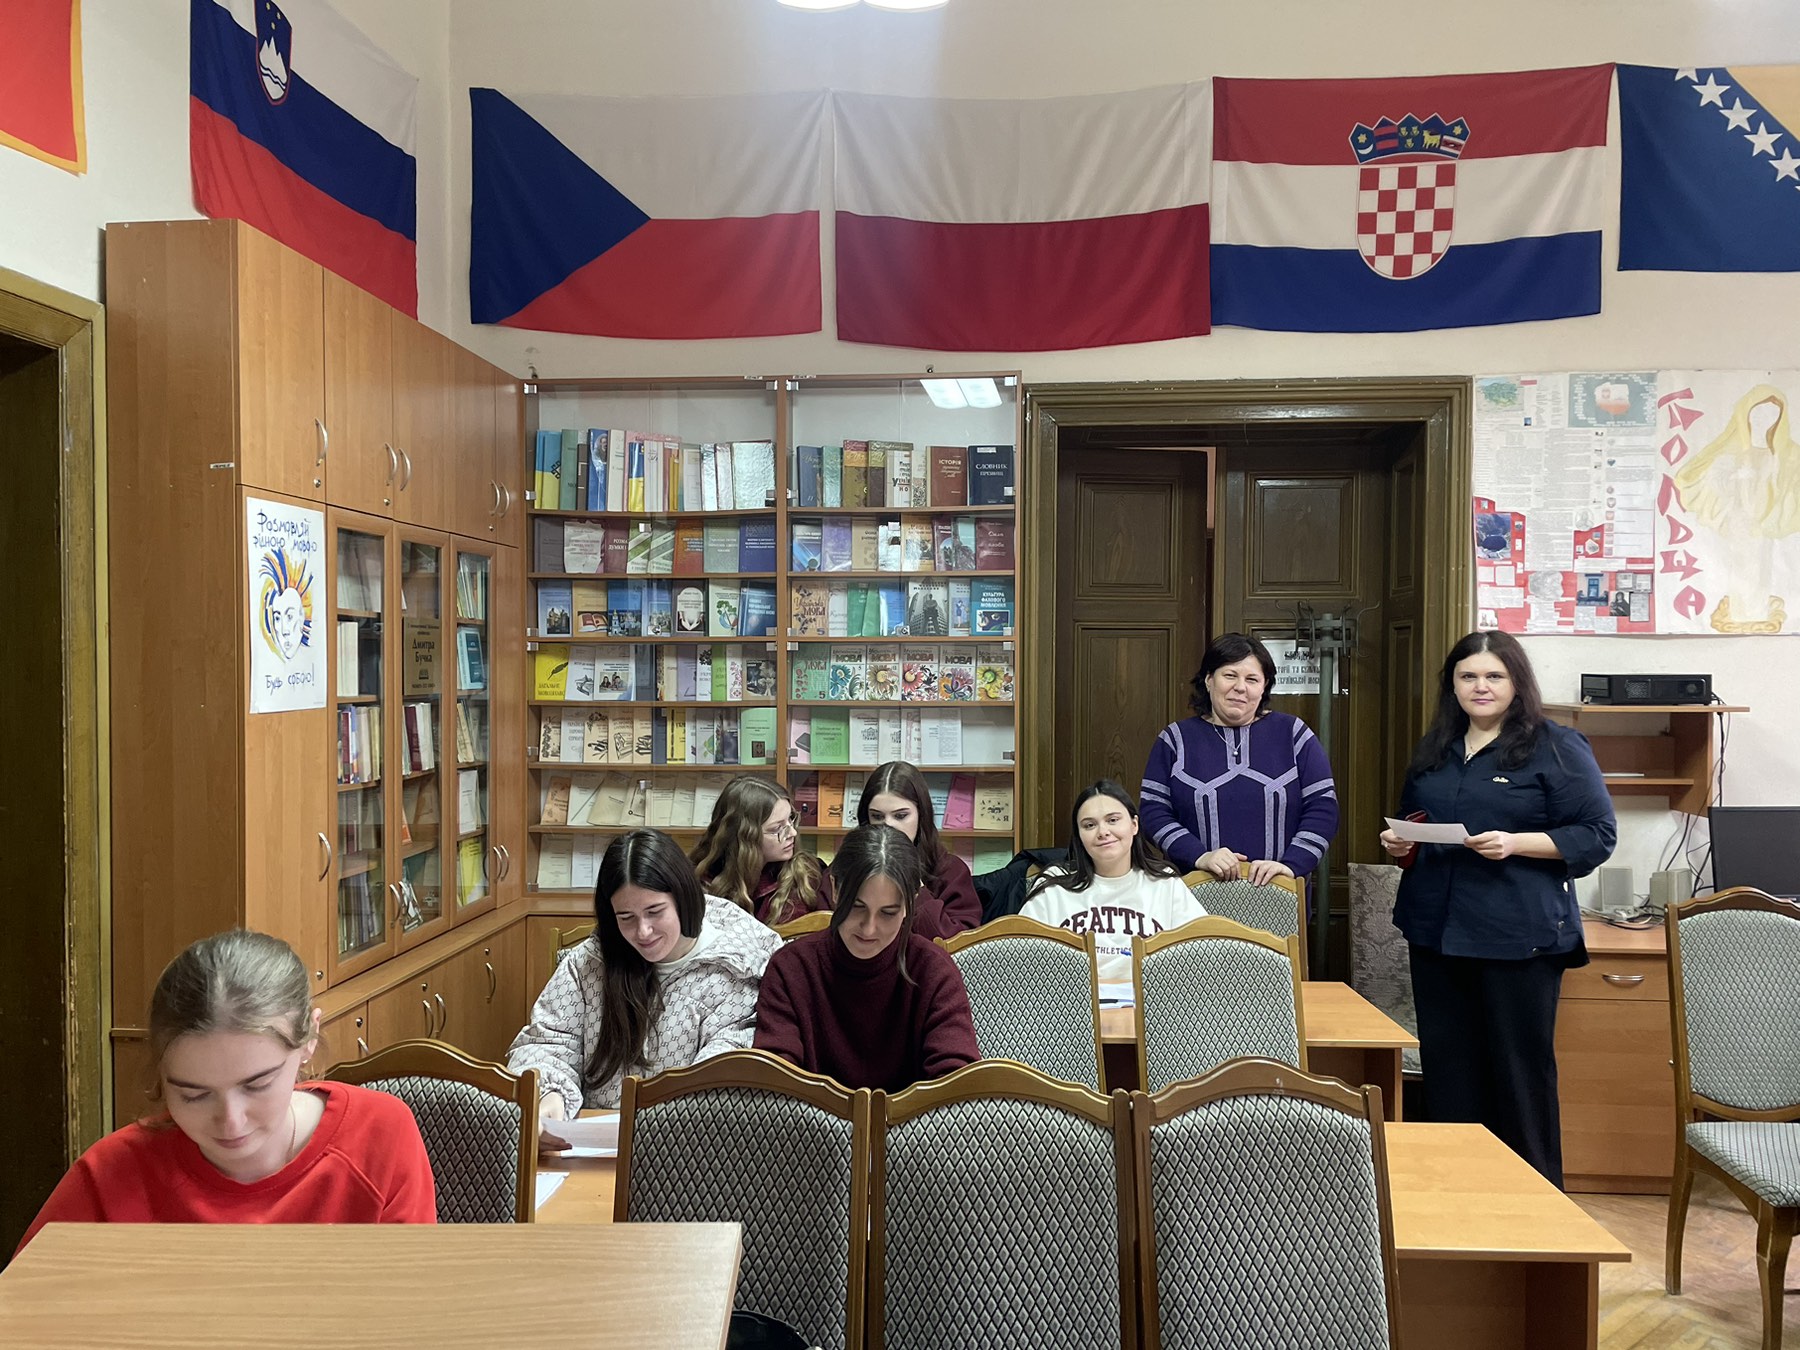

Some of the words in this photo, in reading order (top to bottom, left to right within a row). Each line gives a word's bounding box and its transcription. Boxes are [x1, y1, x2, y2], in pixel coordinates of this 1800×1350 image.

[412, 638, 435, 653] Дмитра
[415, 651, 433, 666] Бучка
[836, 654, 862, 663] МОВА
[871, 653, 896, 662] МОВА
[907, 653, 934, 662] МОВА
[945, 655, 973, 664] МОВА
[982, 655, 1010, 664] МОВА
[819, 690, 826, 699] 5
